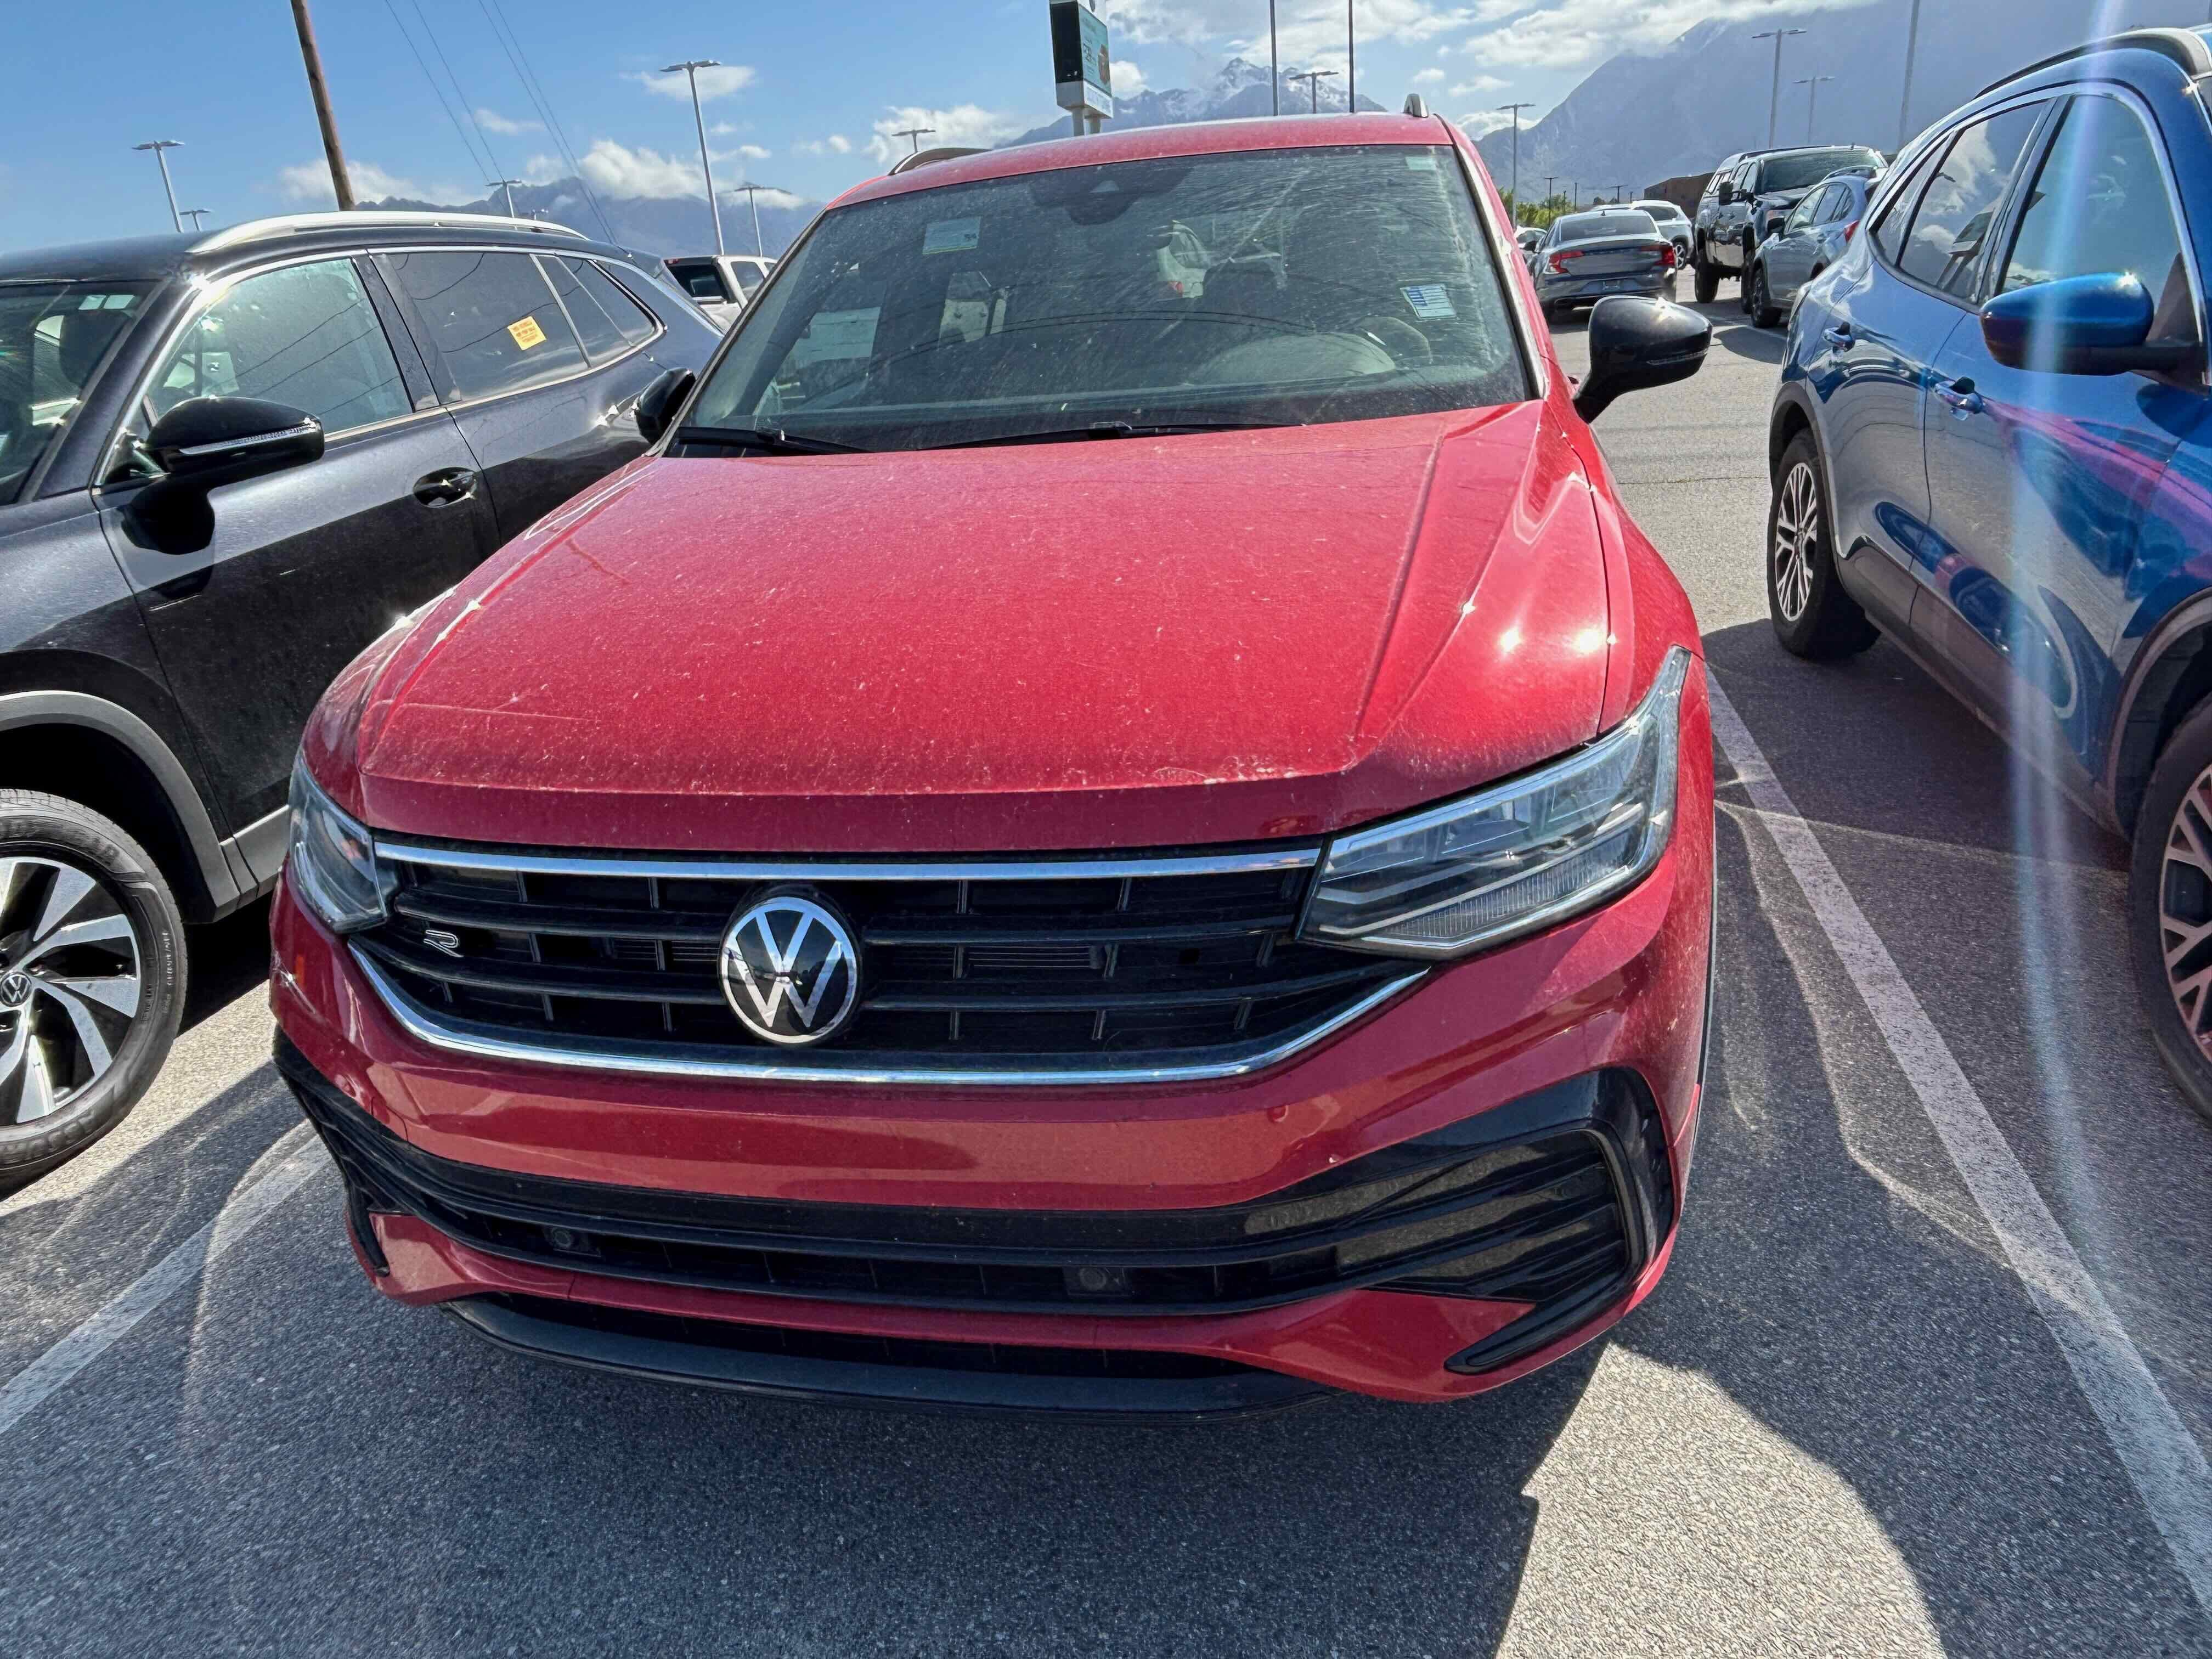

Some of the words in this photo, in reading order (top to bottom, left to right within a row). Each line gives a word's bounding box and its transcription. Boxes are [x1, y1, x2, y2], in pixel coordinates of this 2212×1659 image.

[422, 929, 465, 957] R
[721, 898, 856, 1042] VW
[1, 973, 31, 1006] VW
